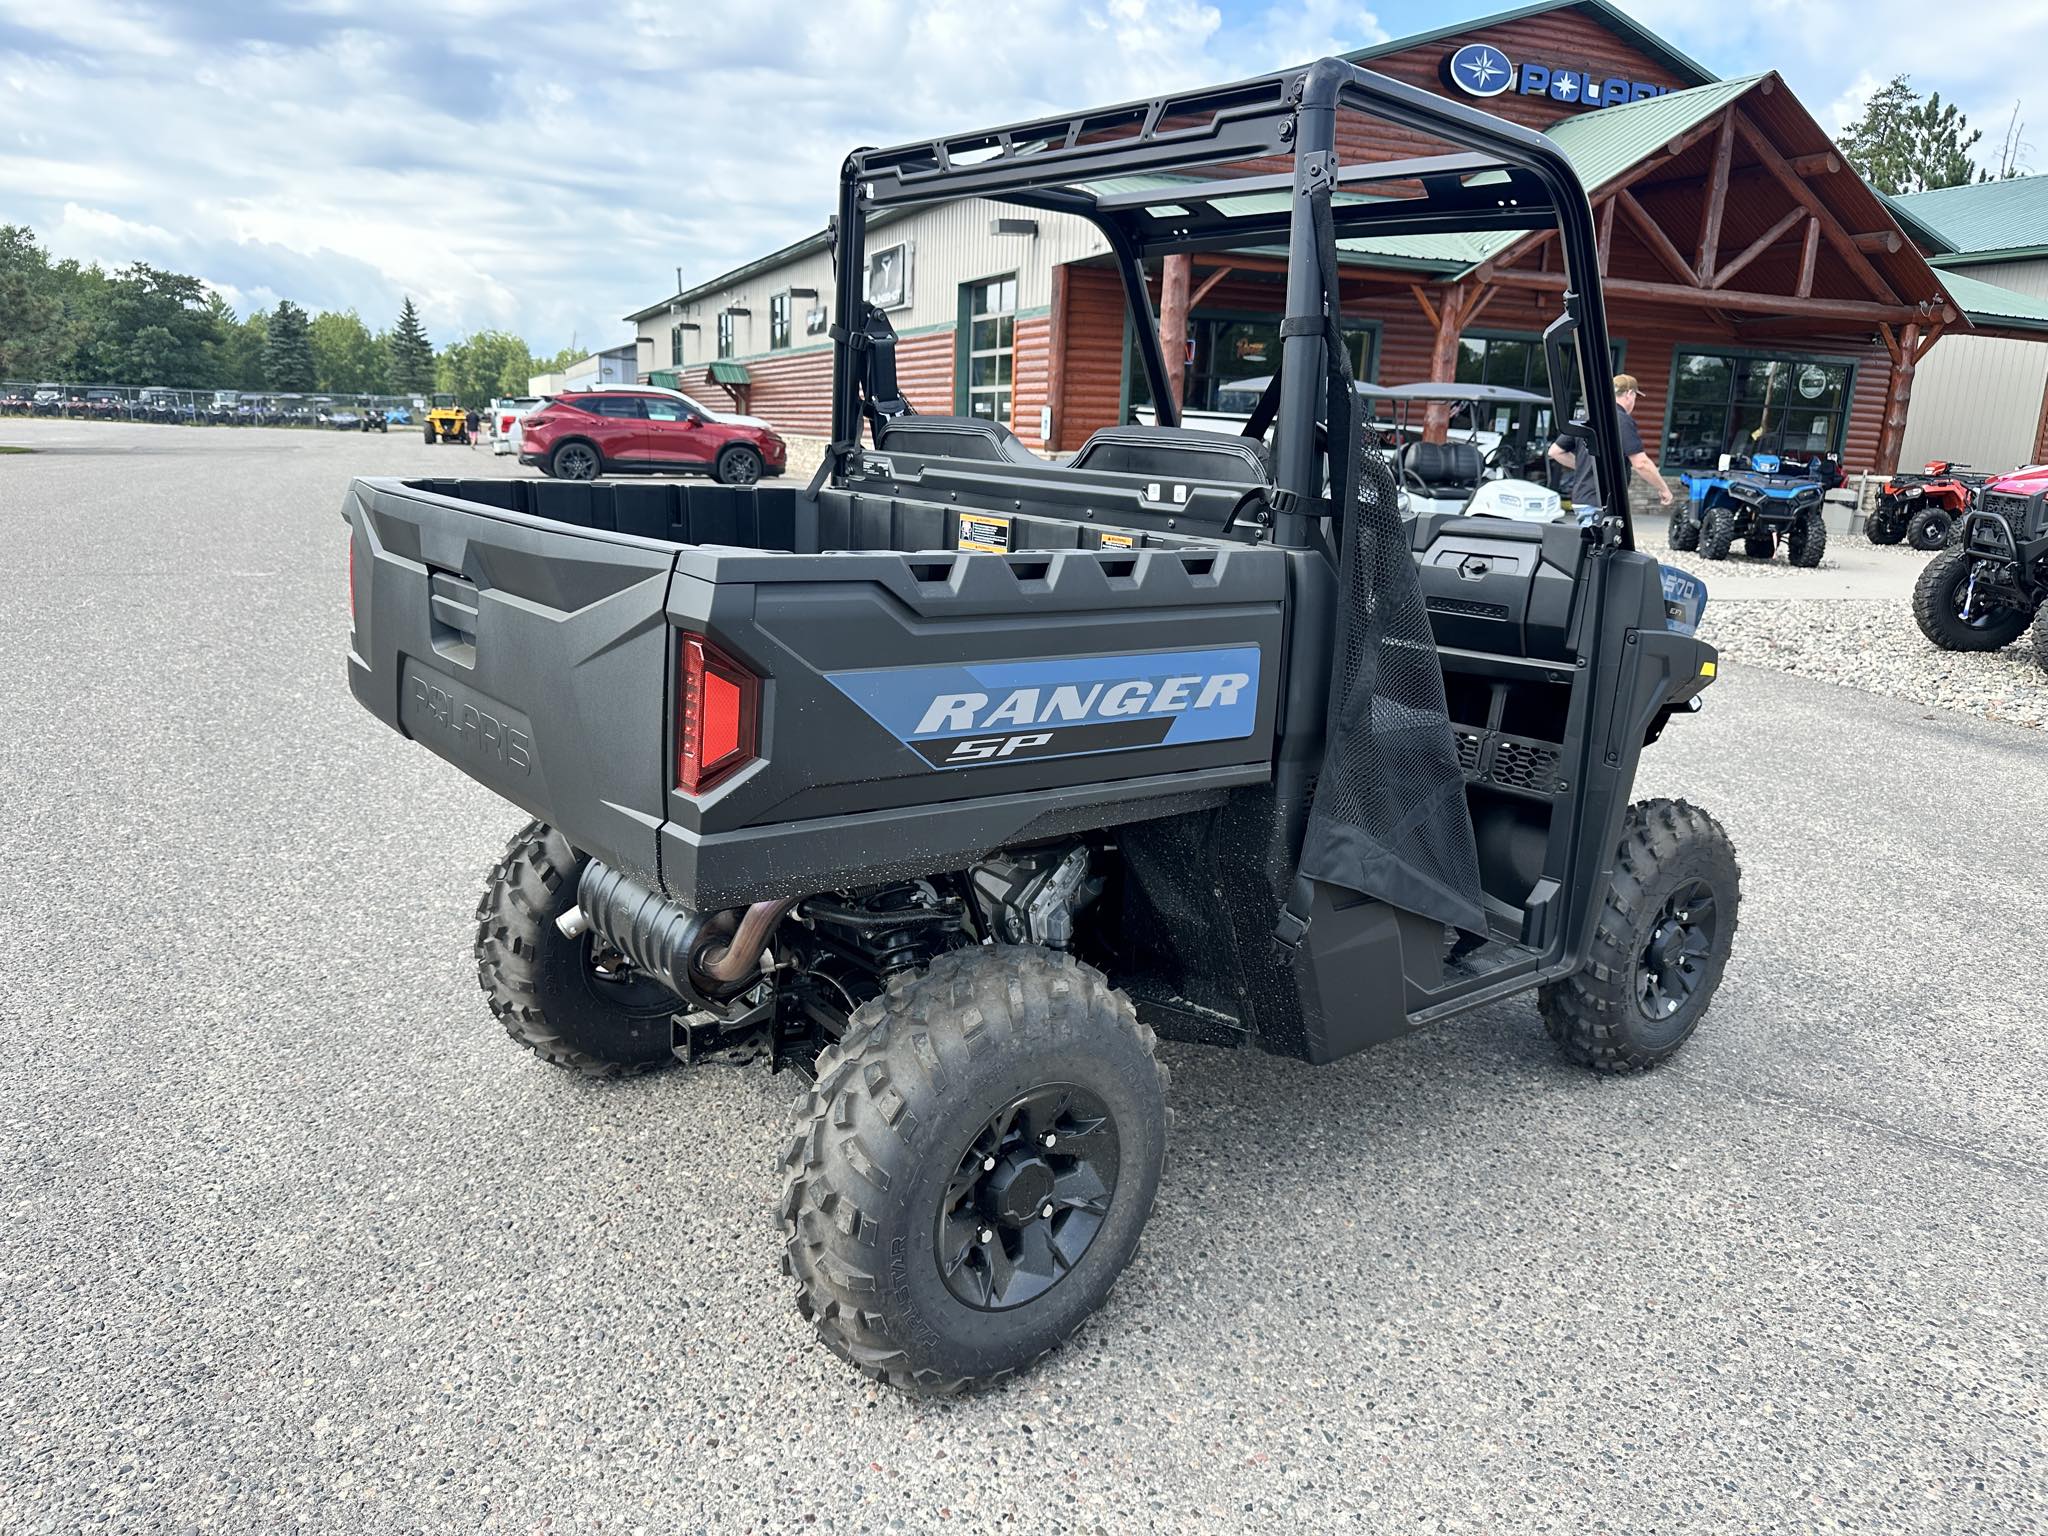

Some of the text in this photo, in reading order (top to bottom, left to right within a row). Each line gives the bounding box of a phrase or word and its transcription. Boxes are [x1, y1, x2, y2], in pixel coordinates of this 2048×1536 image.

[1518, 63, 1680, 108] POLAR
[1663, 574, 1695, 599] 570
[1669, 607, 1682, 616] EFI
[411, 675, 532, 777] POLARIS
[914, 673, 1250, 734] RANGER
[946, 732, 1054, 762] SP
[890, 1235, 941, 1348] CARLSTAR
